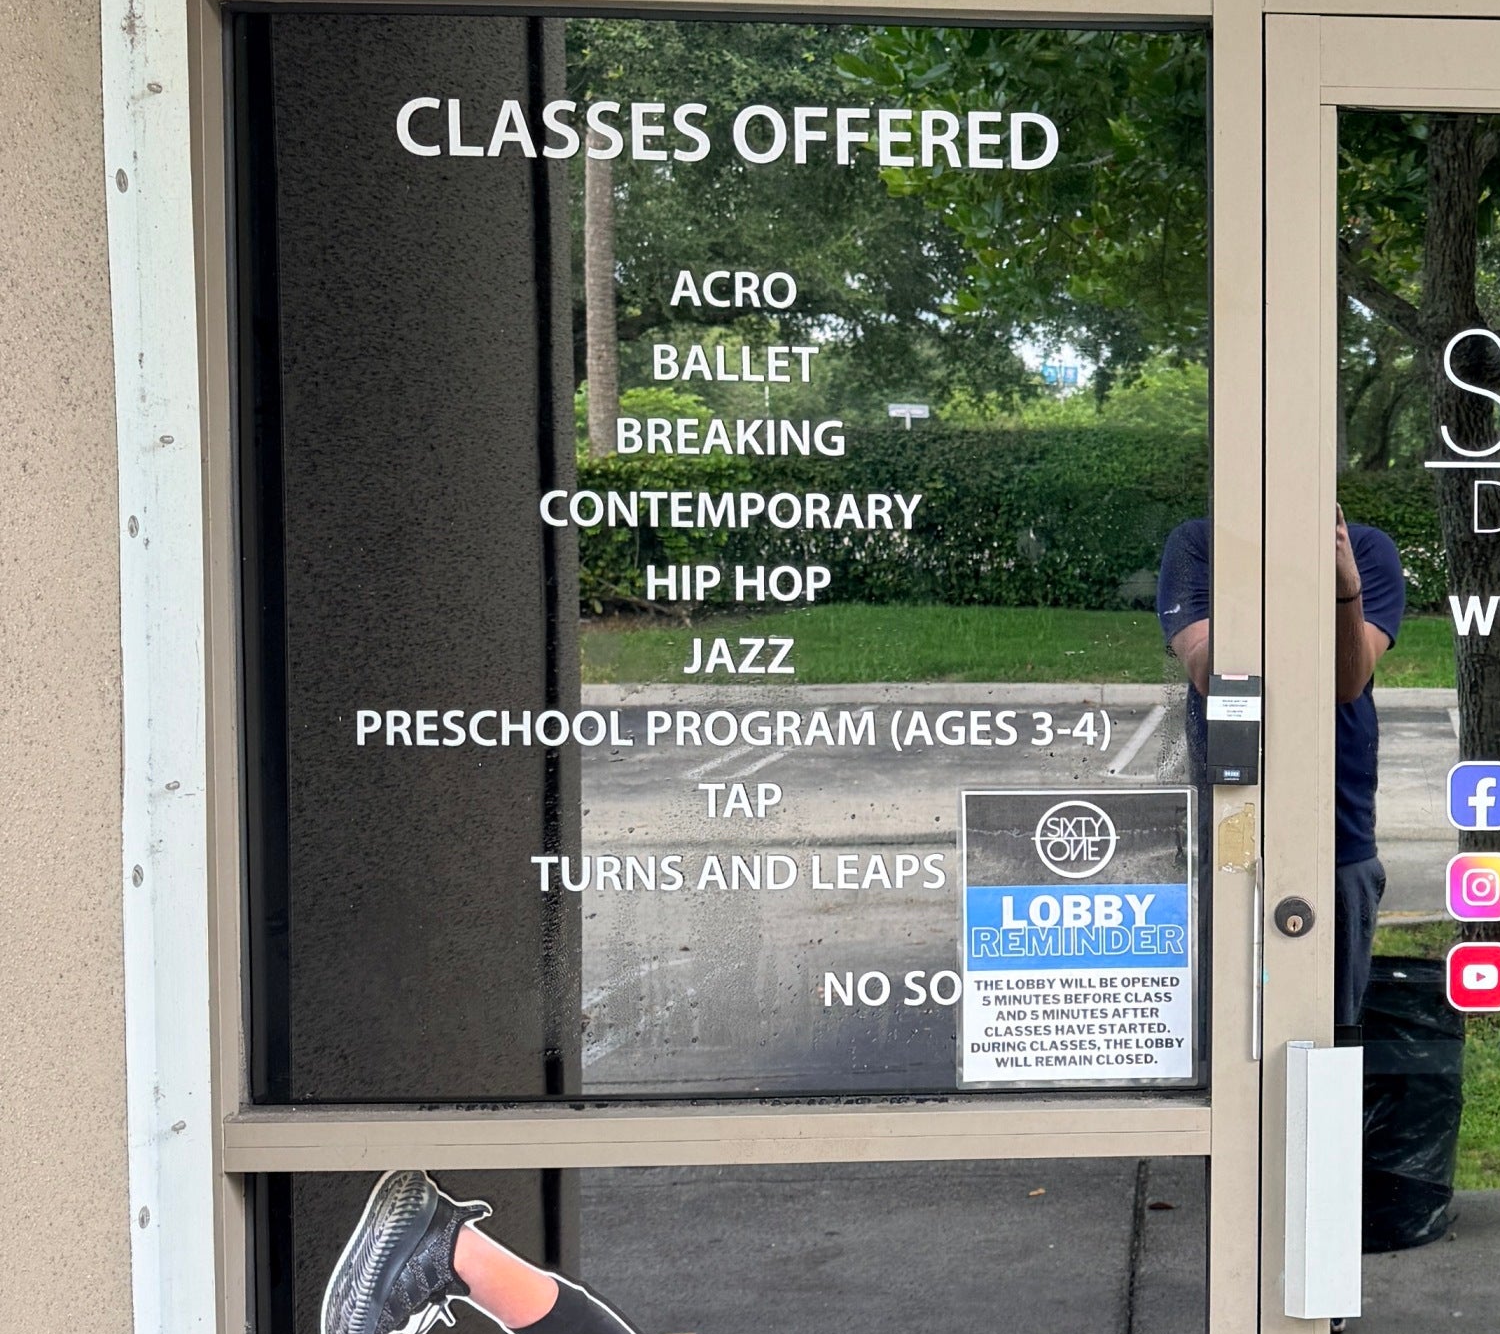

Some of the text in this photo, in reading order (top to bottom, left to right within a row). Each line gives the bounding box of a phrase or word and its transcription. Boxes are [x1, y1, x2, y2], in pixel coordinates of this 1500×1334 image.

[396, 97, 1060, 171] CLASSES OFFERED
[669, 271, 798, 309] ACRO
[653, 344, 820, 383] BALLET
[616, 418, 846, 458] BREAKING
[539, 489, 924, 530] CONTEMPORARY
[646, 564, 833, 603] HIP HOP
[683, 637, 797, 675] JAZZ
[357, 709, 1113, 753] PRESCHOOL PROGRAM (AGES 3-4)
[698, 782, 783, 819] TAP
[1047, 818, 1103, 837] SIXTY
[1047, 837, 1100, 861] ONE
[531, 853, 947, 893] TURNS AND LEAPS
[1002, 894, 1155, 928] LOBBY
[971, 925, 1184, 957] REMINDER
[823, 969, 892, 1008] NO
[975, 977, 1180, 991] THE LOBBY WILL BE OPENED
[982, 992, 1172, 1006] 5 MINUTES BEFORE CLASS
[984, 1023, 1171, 1037] CLASSES HAVE STARTED.
[996, 1008, 1159, 1021] AND 5 MINUTES AFTER
[971, 1038, 1184, 1053] DURING CLASSES, THE LOBBY
[995, 1054, 1158, 1067] WILL REMAIN CLOSED.
